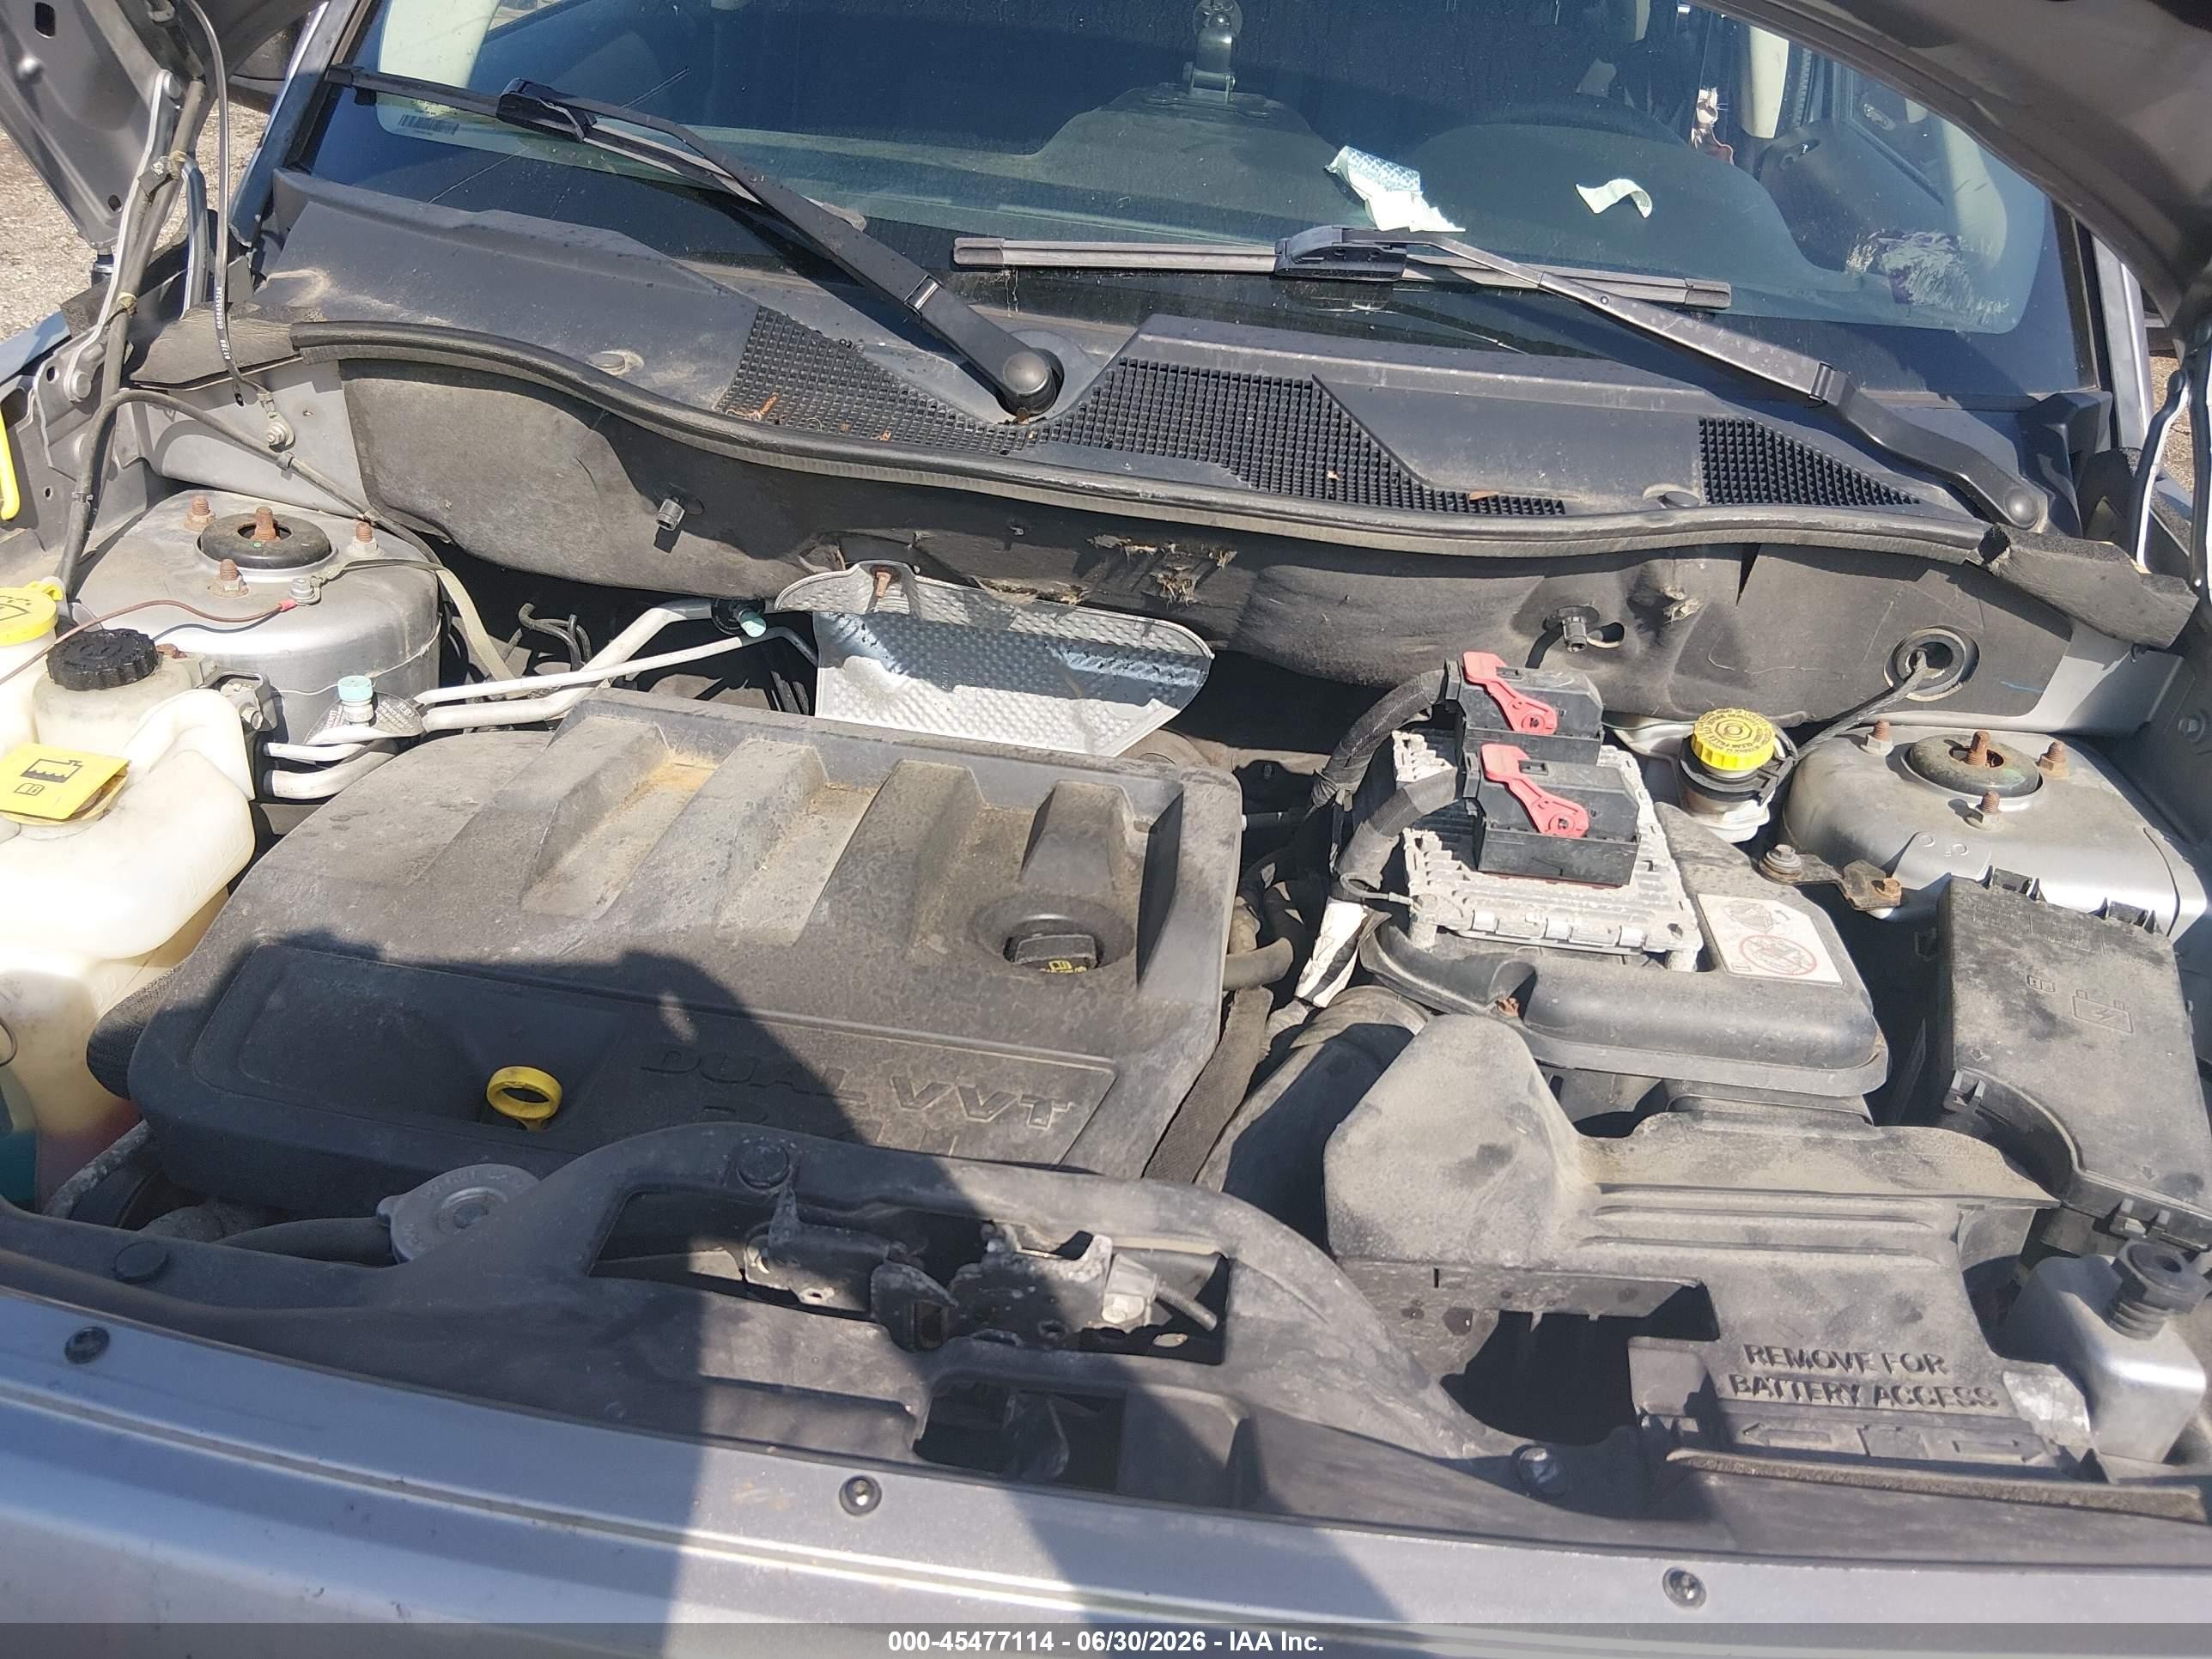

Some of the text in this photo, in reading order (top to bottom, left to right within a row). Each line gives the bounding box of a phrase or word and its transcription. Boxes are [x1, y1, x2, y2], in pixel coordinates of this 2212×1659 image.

[889, 1074, 1075, 1131] VVT
[1742, 1343, 1949, 1375] REMOVE FOR
[1729, 1373, 1999, 1408] BATTERY ACCESS
